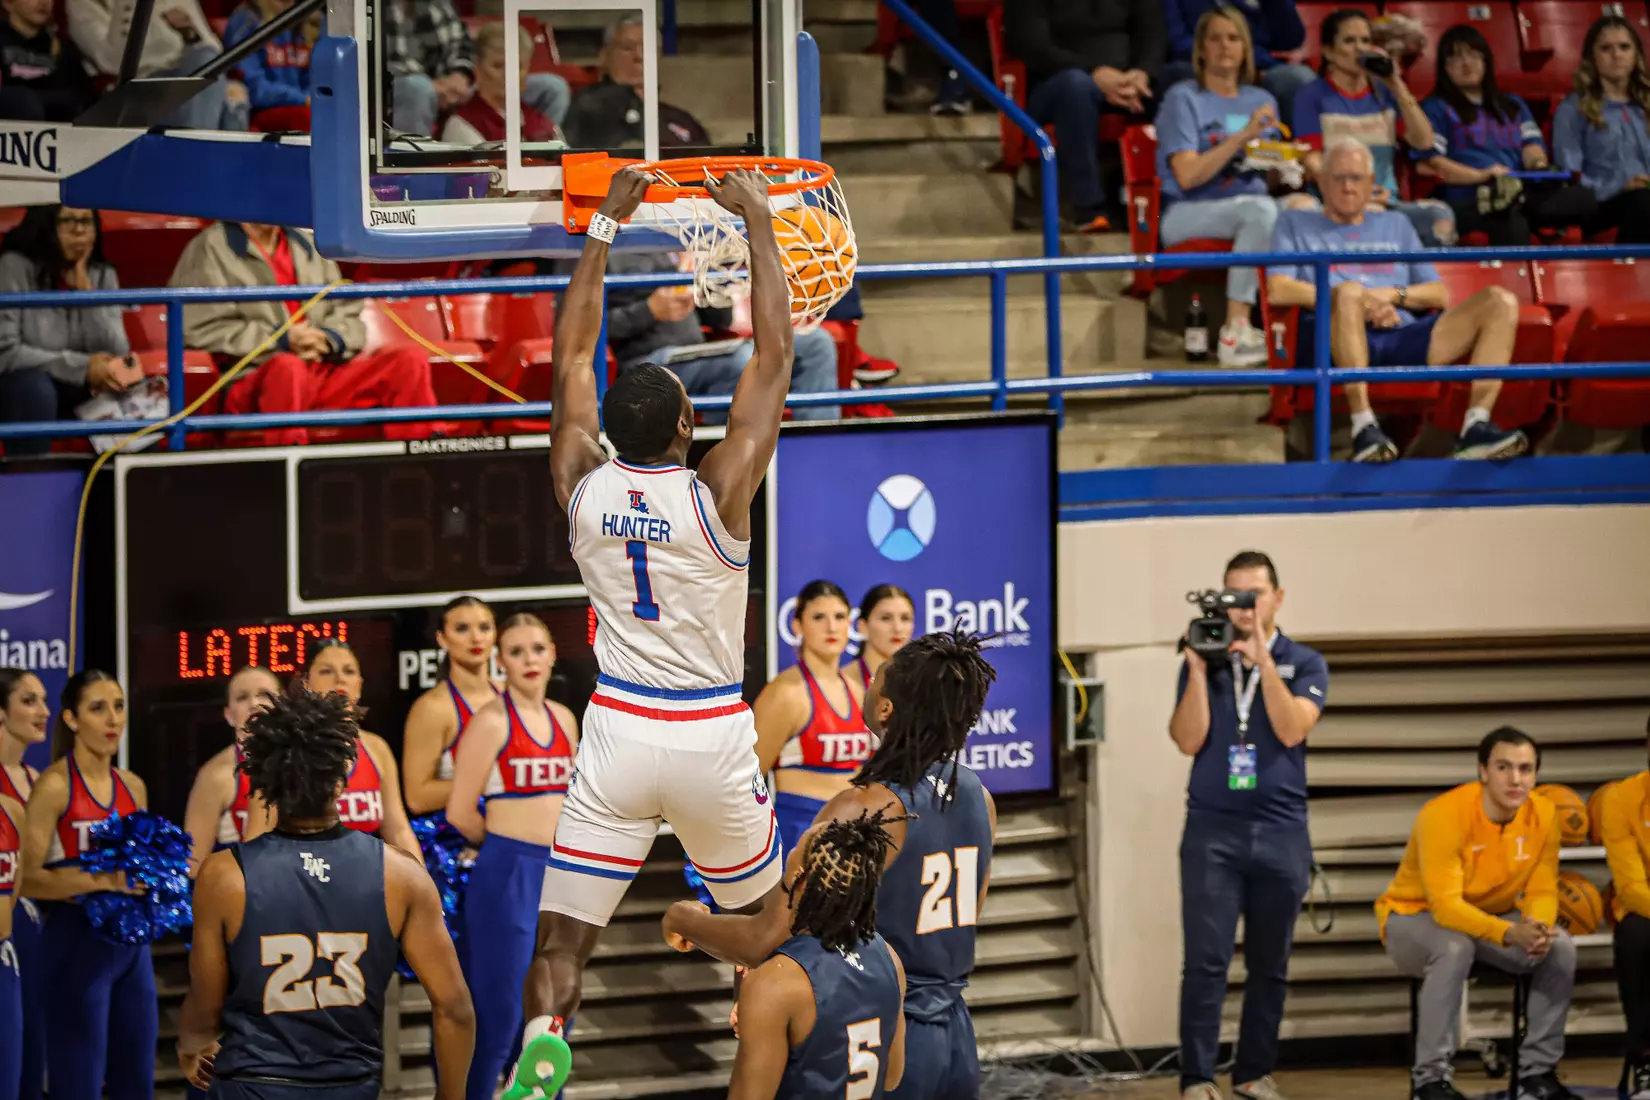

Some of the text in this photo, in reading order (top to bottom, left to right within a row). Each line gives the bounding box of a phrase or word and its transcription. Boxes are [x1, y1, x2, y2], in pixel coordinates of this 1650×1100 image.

[370, 209, 416, 227] SPALDING
[409, 436, 507, 455] DAKTRONICS
[602, 513, 672, 543] HUNTER
[624, 540, 661, 622] 1
[924, 581, 1031, 636] Bank
[179, 628, 231, 679] LA
[966, 707, 1018, 736] ANK
[949, 740, 1035, 771] LETICS
[335, 789, 384, 823] ECH
[299, 851, 331, 883] TWC
[916, 846, 979, 935] 21
[260, 932, 369, 1015] 23
[846, 1017, 882, 1100] 5
